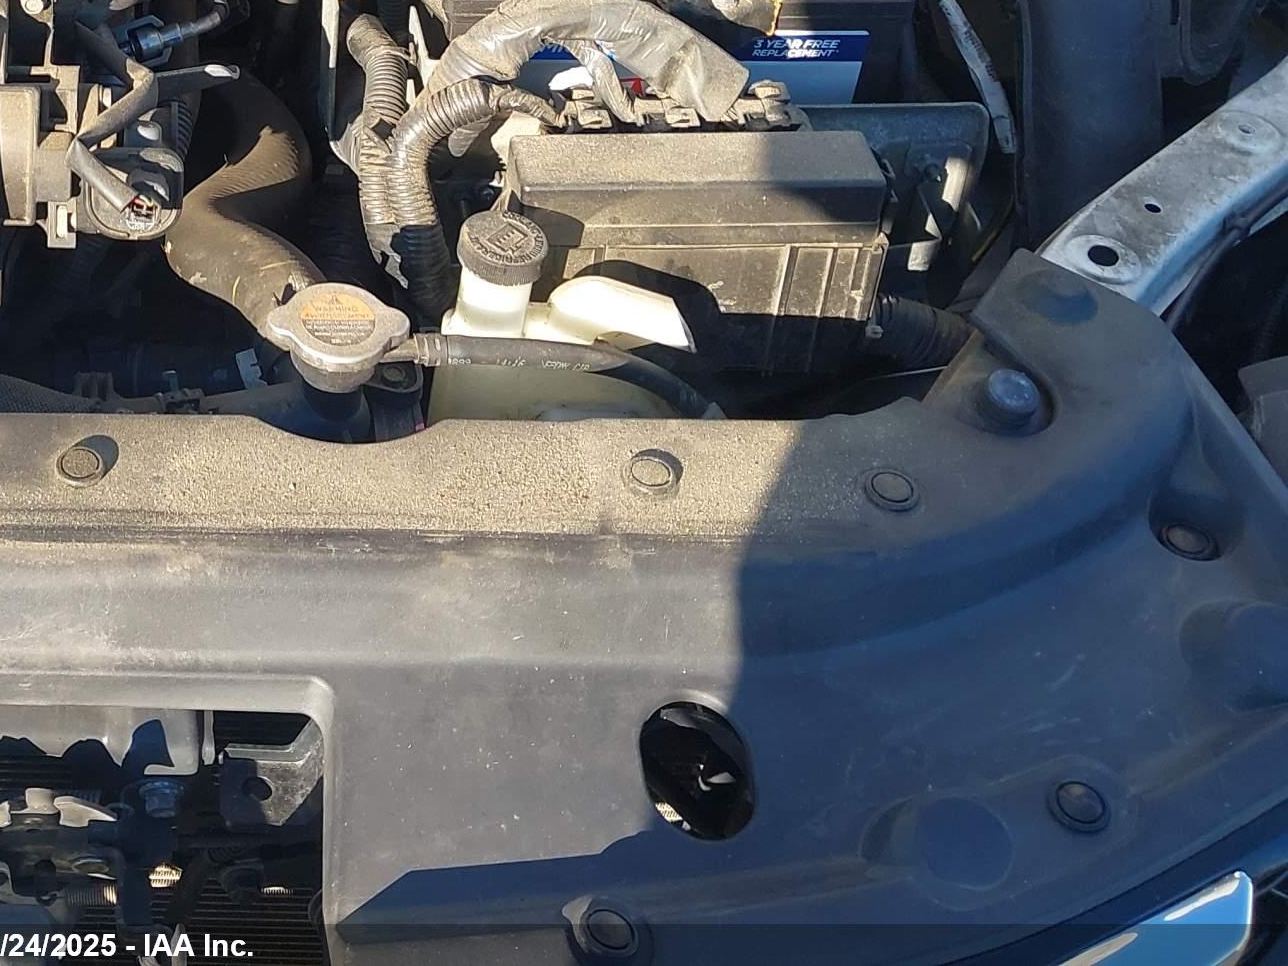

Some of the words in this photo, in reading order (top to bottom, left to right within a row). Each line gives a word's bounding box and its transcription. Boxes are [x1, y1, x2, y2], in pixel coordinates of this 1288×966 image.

[754, 39, 763, 48] 3
[766, 38, 803, 49] YEAR
[803, 39, 841, 48] FREE
